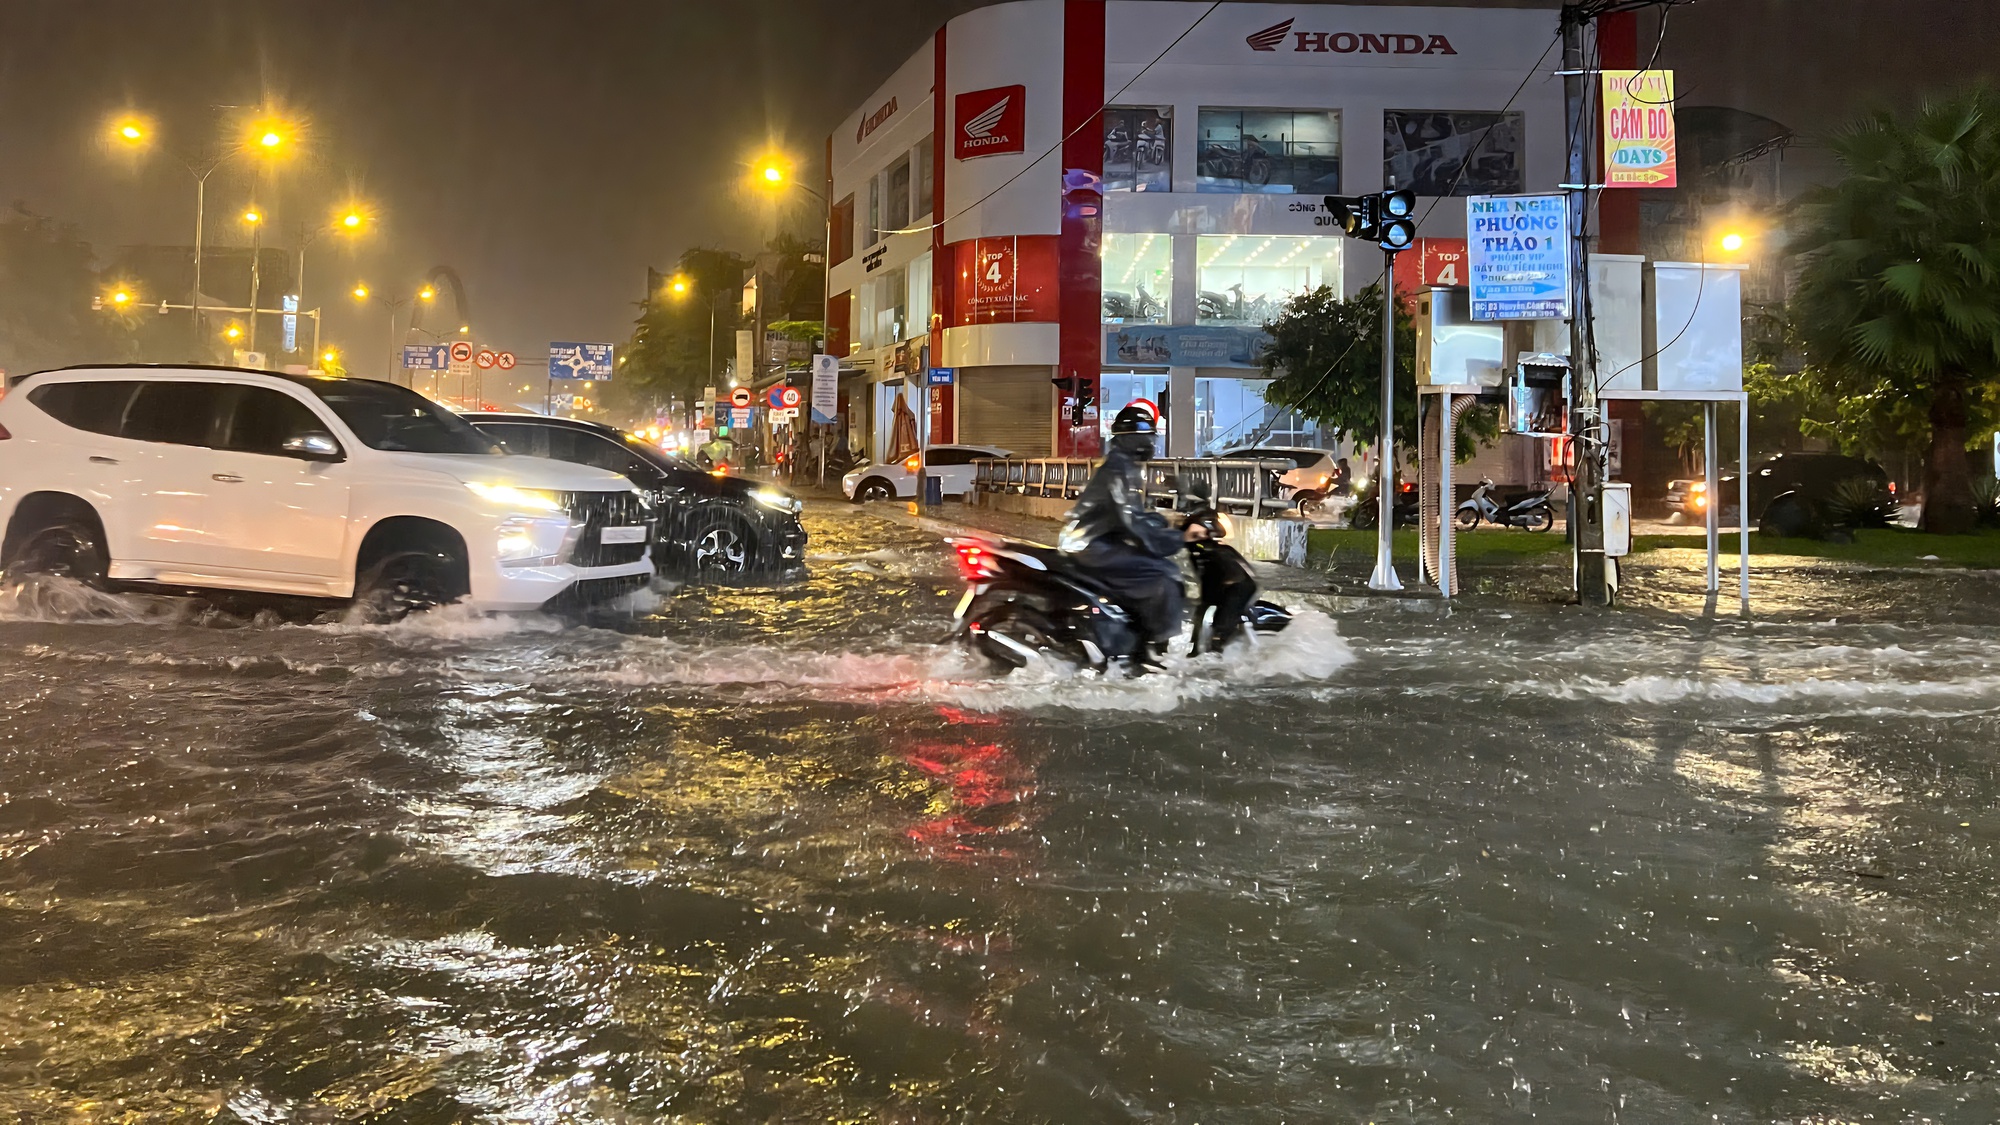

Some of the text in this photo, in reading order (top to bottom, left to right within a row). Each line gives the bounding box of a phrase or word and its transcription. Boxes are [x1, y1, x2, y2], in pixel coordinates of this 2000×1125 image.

[1294, 32, 1458, 54] HONDA
[963, 135, 1009, 148] HONDA
[1618, 149, 1662, 164] DAYS
[1288, 201, 1316, 212] CÔNG
[1475, 214, 1559, 231] PHƯƠNG
[1482, 231, 1553, 252] THẢO 1
[1438, 253, 1460, 261] TOP
[1529, 253, 1545, 261] VIP
[986, 262, 1002, 283] 4
[1437, 263, 1458, 286] 4
[786, 393, 796, 402] 40
